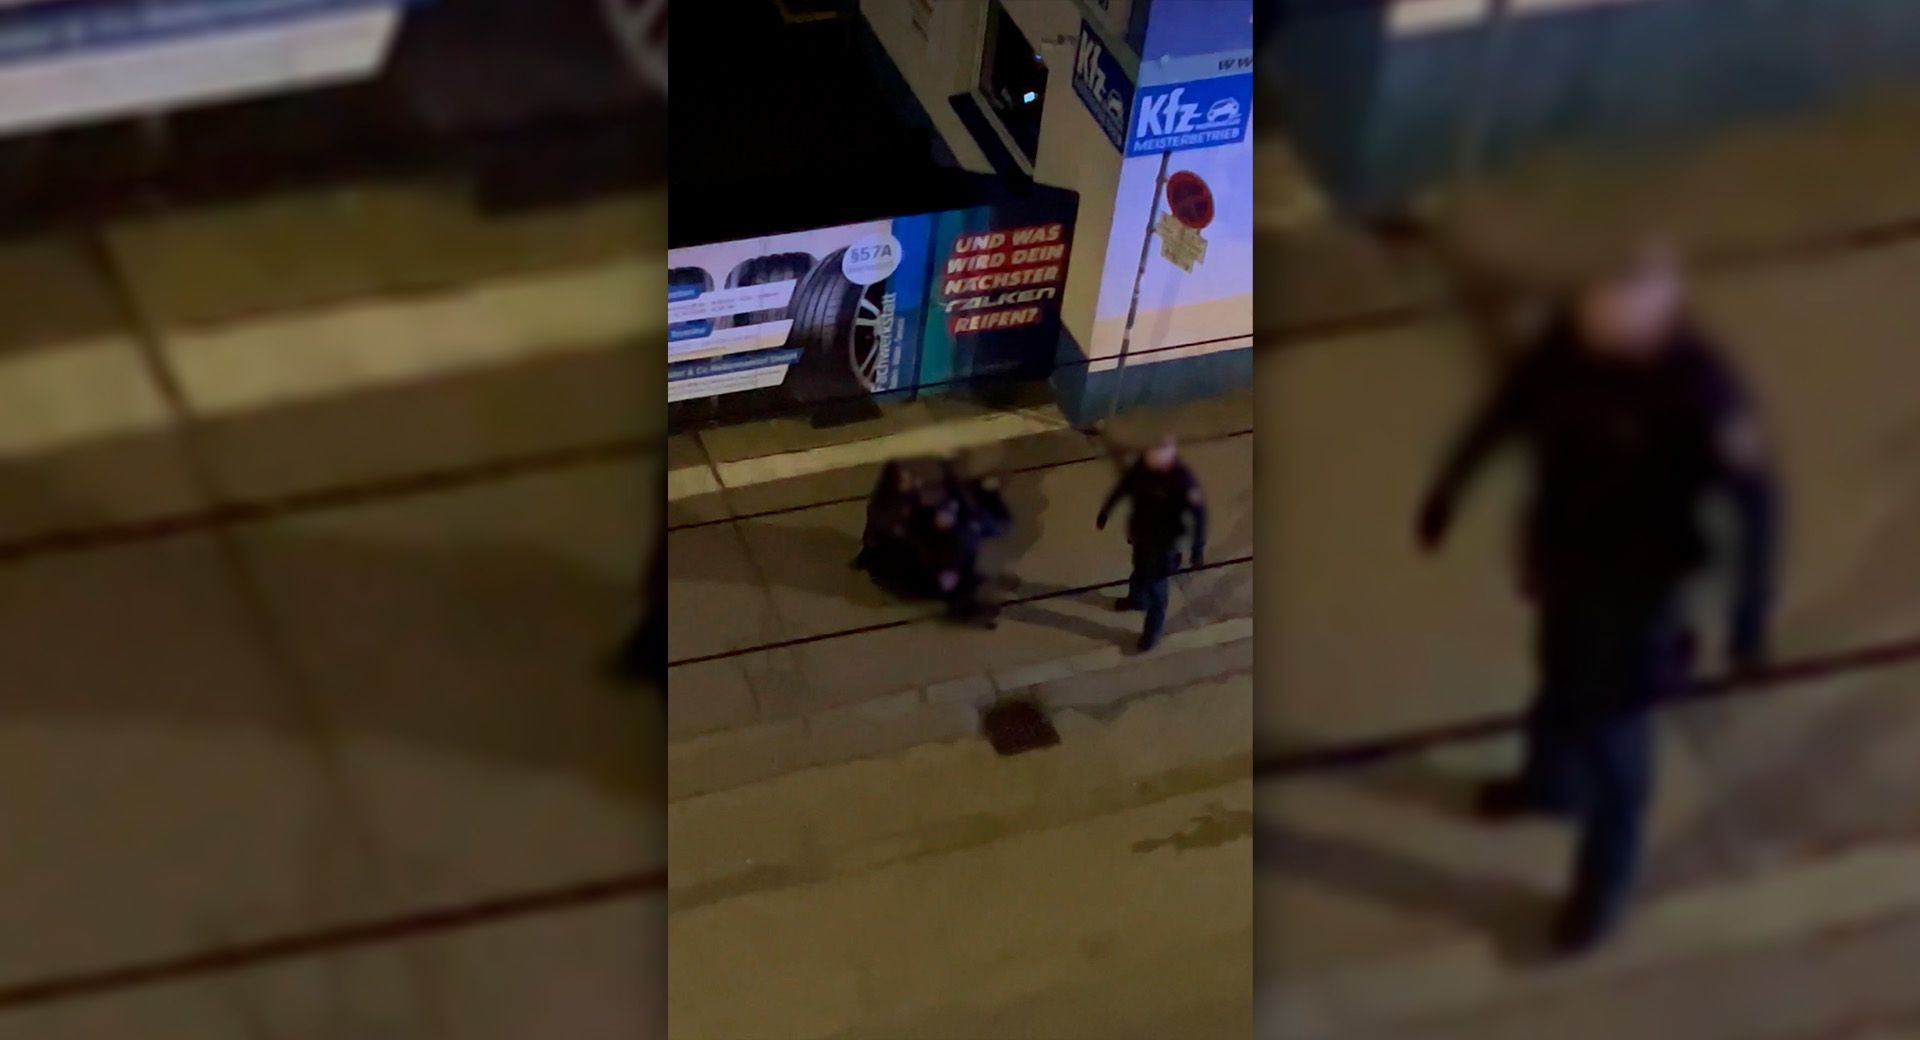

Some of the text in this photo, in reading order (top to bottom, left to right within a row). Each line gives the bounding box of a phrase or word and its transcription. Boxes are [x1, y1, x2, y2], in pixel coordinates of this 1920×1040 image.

[1136, 87, 1202, 138] Kfz
[1134, 128, 1240, 151] MEISTERBETRIEB
[956, 224, 1062, 253] UND WAS
[850, 244, 892, 263] §57A
[948, 244, 1065, 273] WIRD DEIN
[954, 308, 1039, 333] REIFEN?
